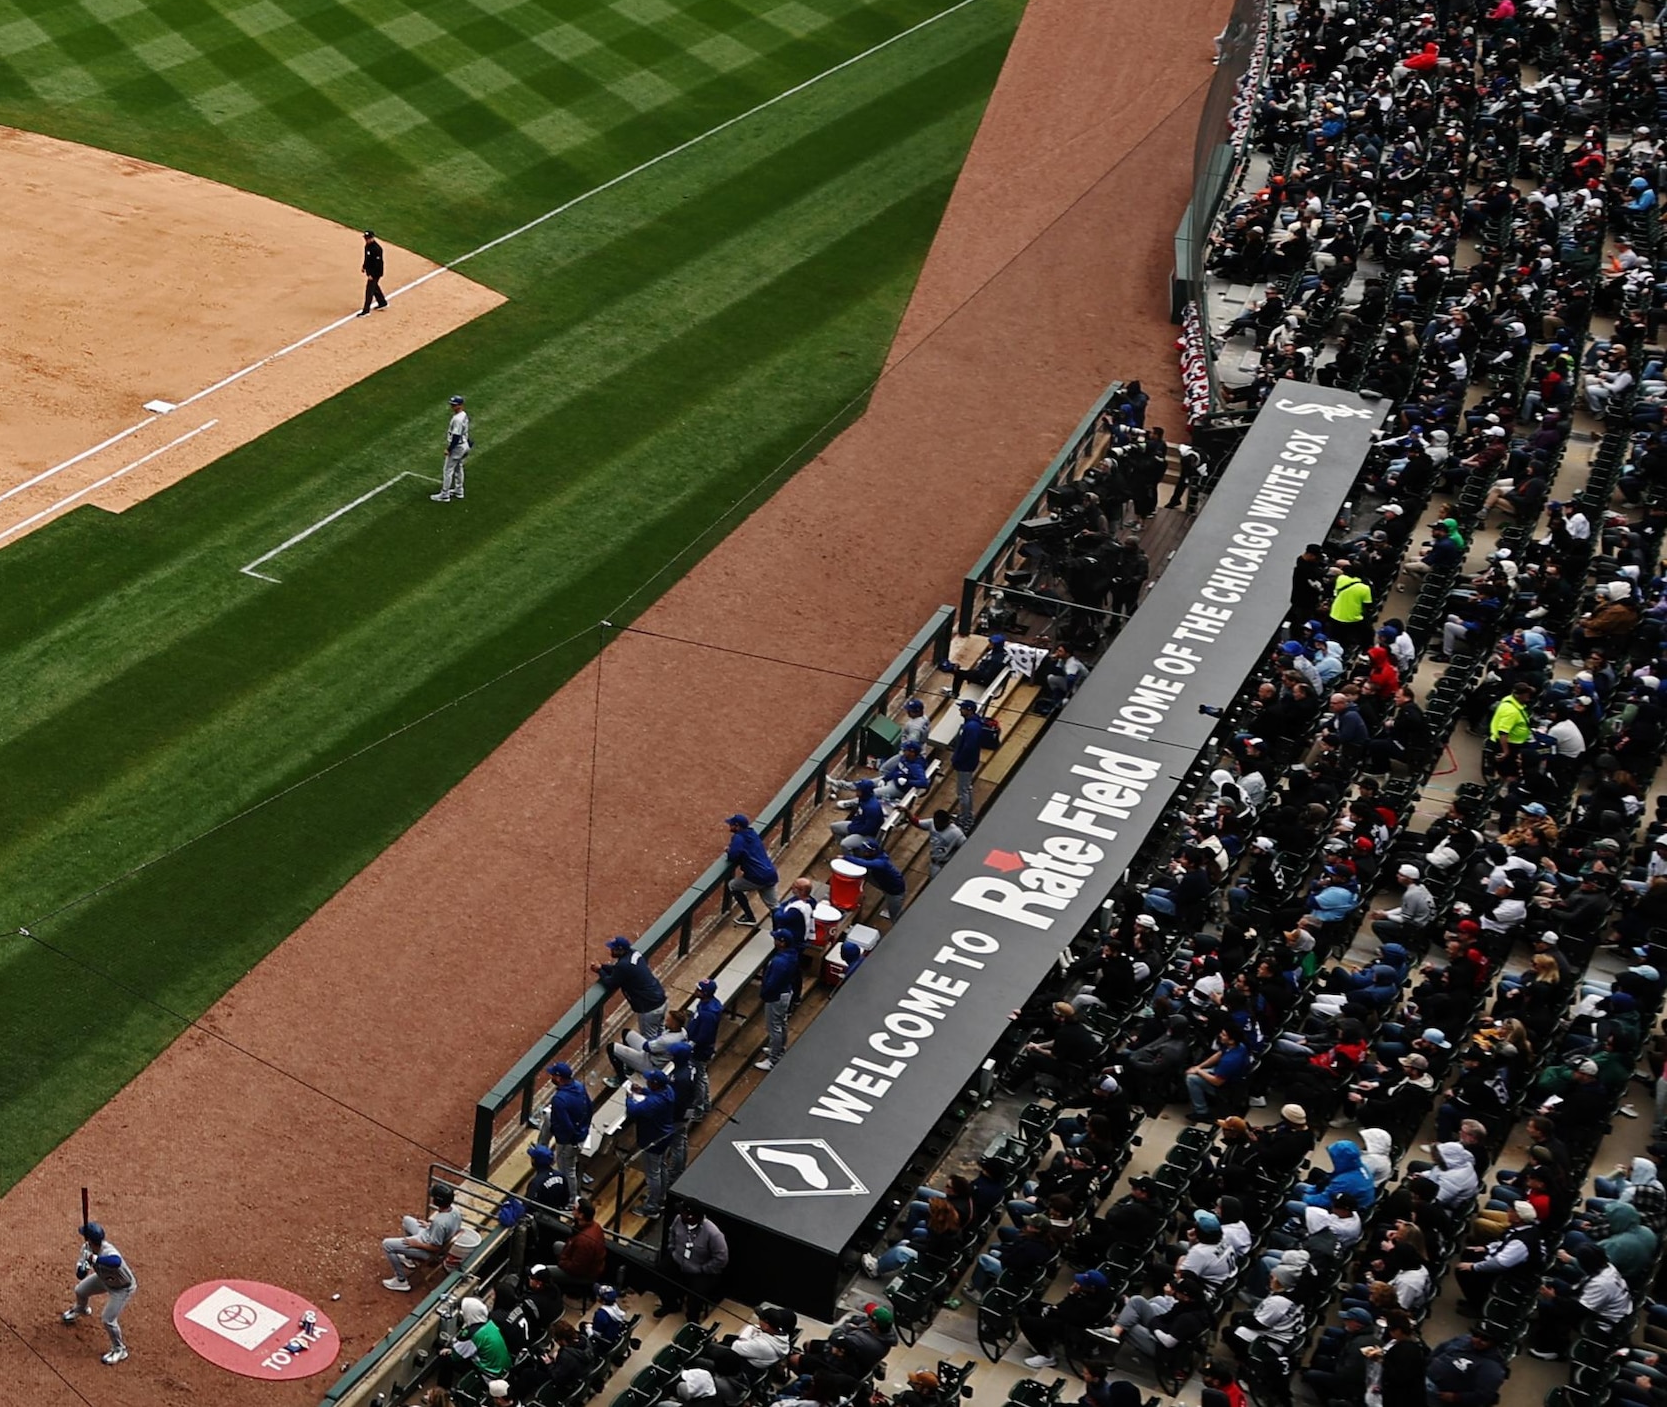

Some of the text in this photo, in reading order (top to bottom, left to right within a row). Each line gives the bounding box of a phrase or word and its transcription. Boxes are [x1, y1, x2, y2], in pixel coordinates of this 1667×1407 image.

[808, 429, 1330, 1124] WELCOME TO Rate Field HOME OF THE CHICAGO WHITE SOX
